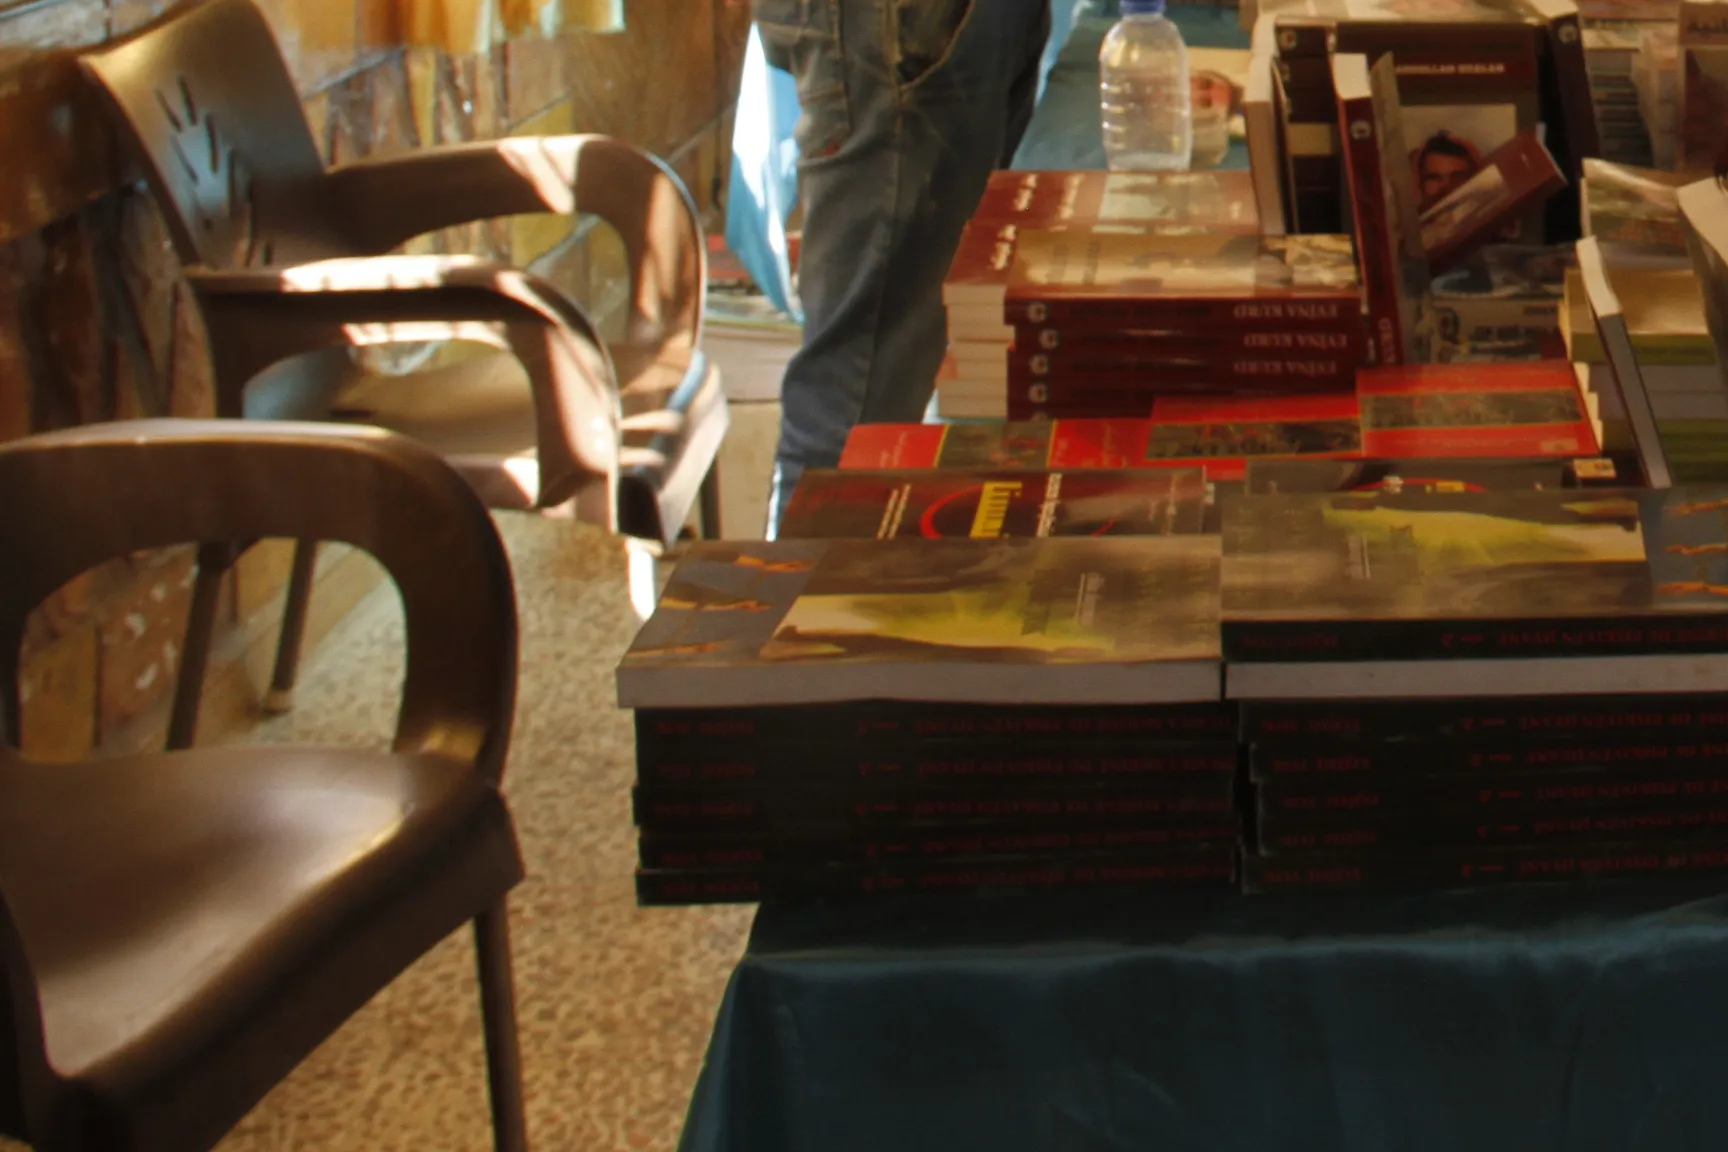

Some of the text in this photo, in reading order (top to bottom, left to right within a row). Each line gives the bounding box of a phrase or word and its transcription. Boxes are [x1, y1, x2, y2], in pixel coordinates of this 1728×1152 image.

[1233, 303, 1282, 318] KURD
[1243, 333, 1293, 347] KURD
[1233, 360, 1282, 374] KURD
